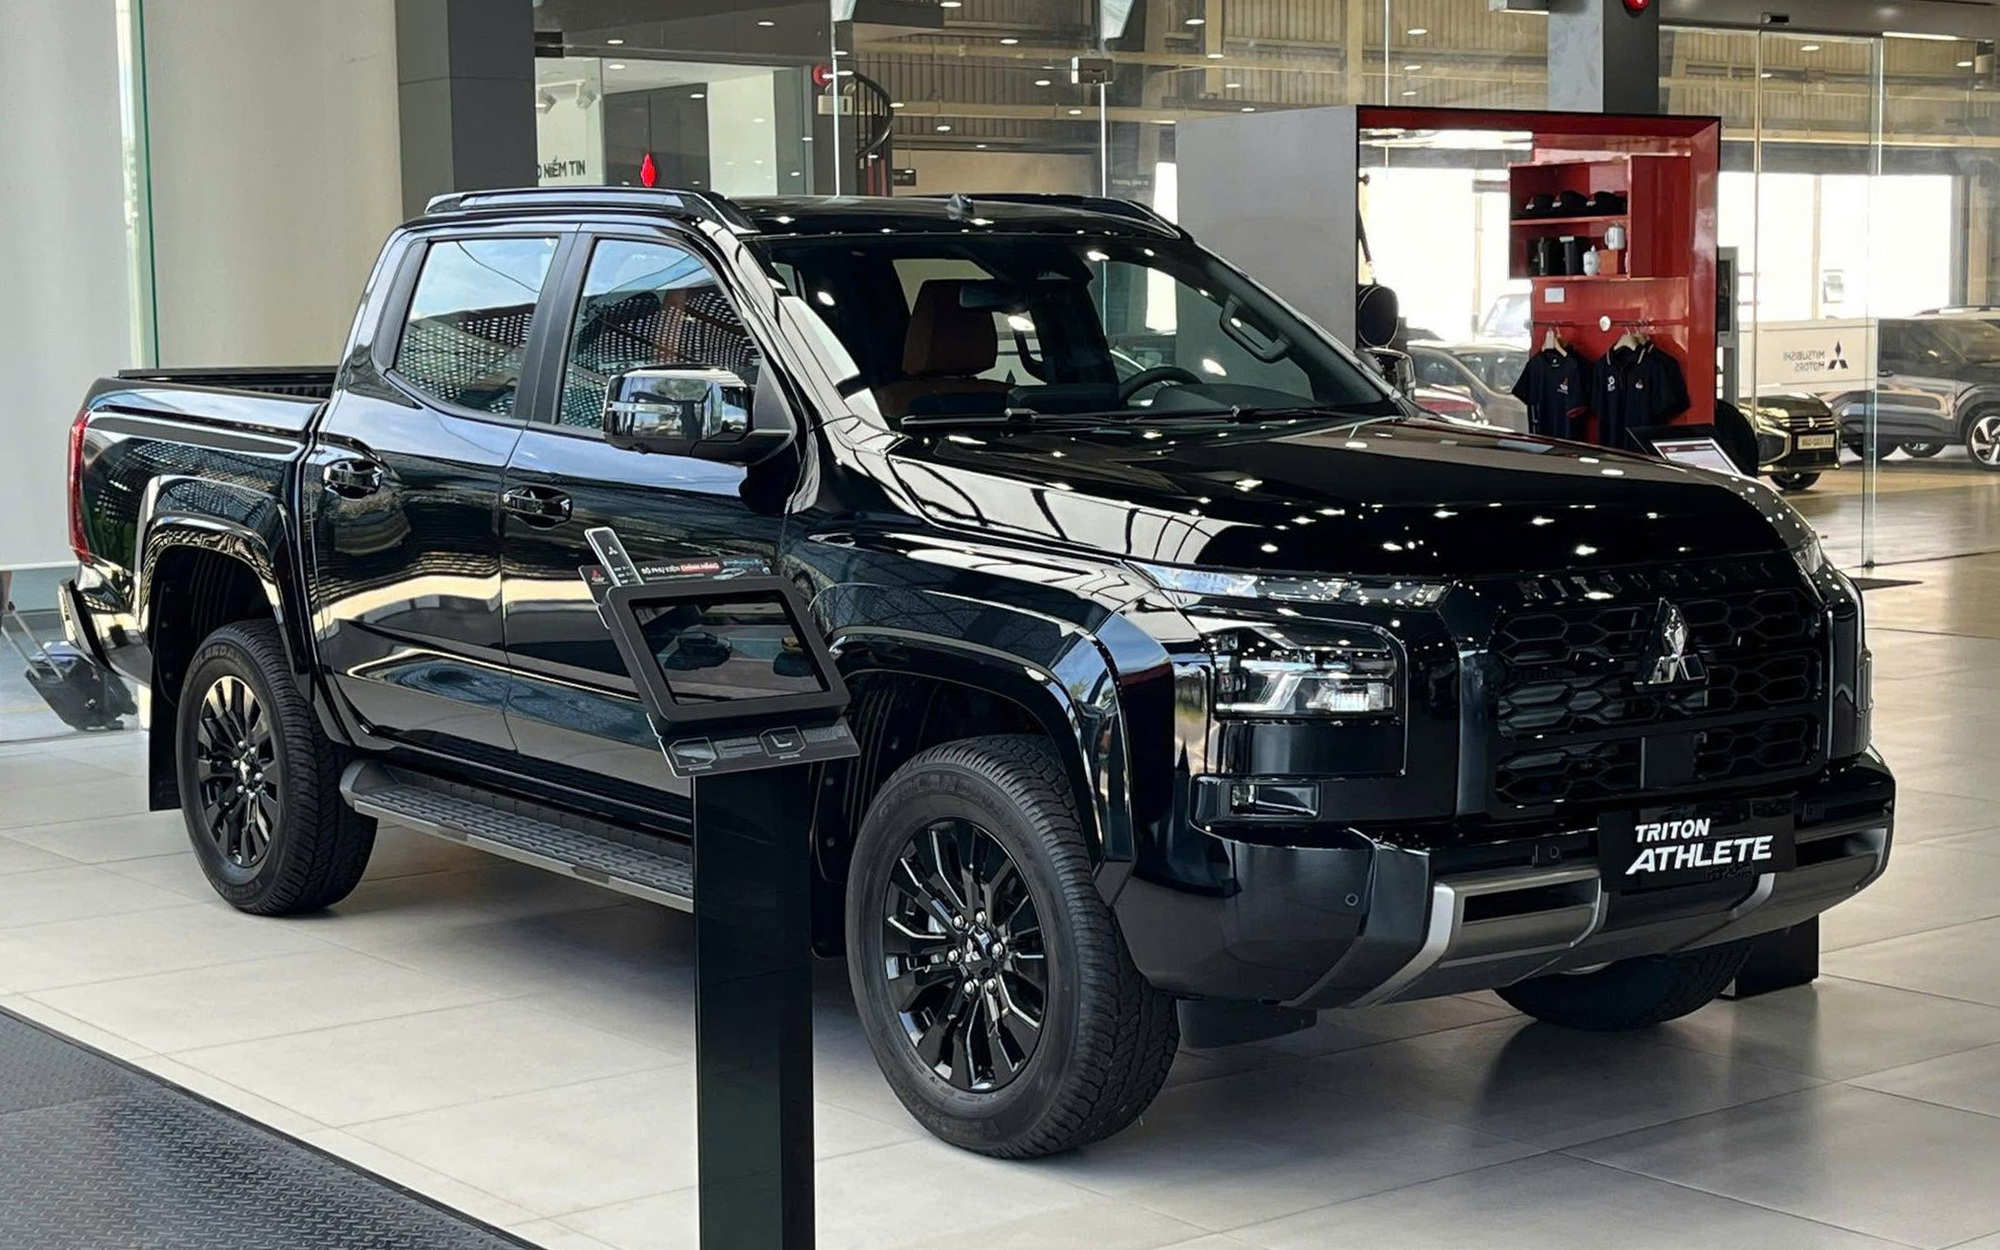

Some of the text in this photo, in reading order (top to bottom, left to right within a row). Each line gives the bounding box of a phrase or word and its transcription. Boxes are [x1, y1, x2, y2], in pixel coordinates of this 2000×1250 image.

[569, 160, 586, 176] TIN
[1634, 817, 1711, 843] TRITON
[1625, 835, 1774, 875] ATHLETE
